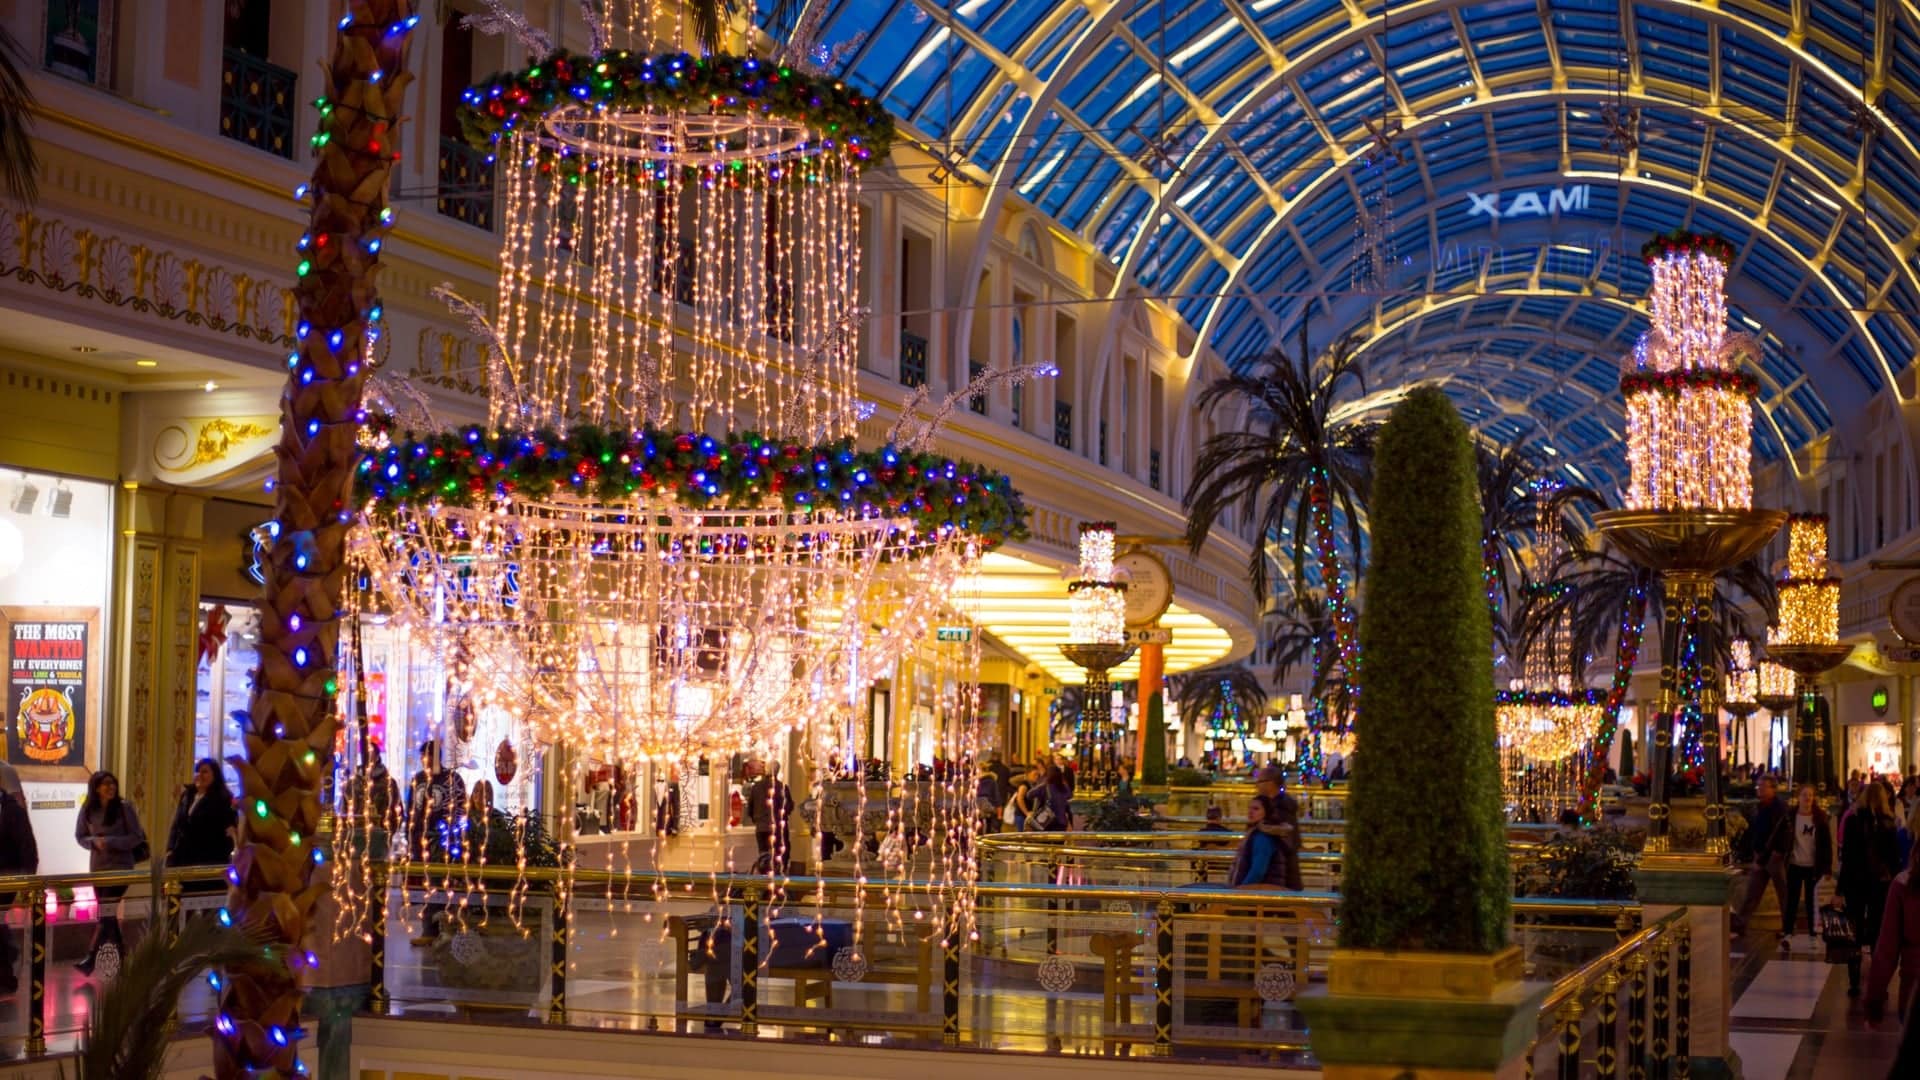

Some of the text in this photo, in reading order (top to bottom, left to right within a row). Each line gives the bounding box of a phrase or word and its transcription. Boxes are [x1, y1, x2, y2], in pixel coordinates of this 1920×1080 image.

[14, 624, 84, 640] THE MOST
[15, 640, 83, 659] WANTED
[13, 659, 26, 669] BY
